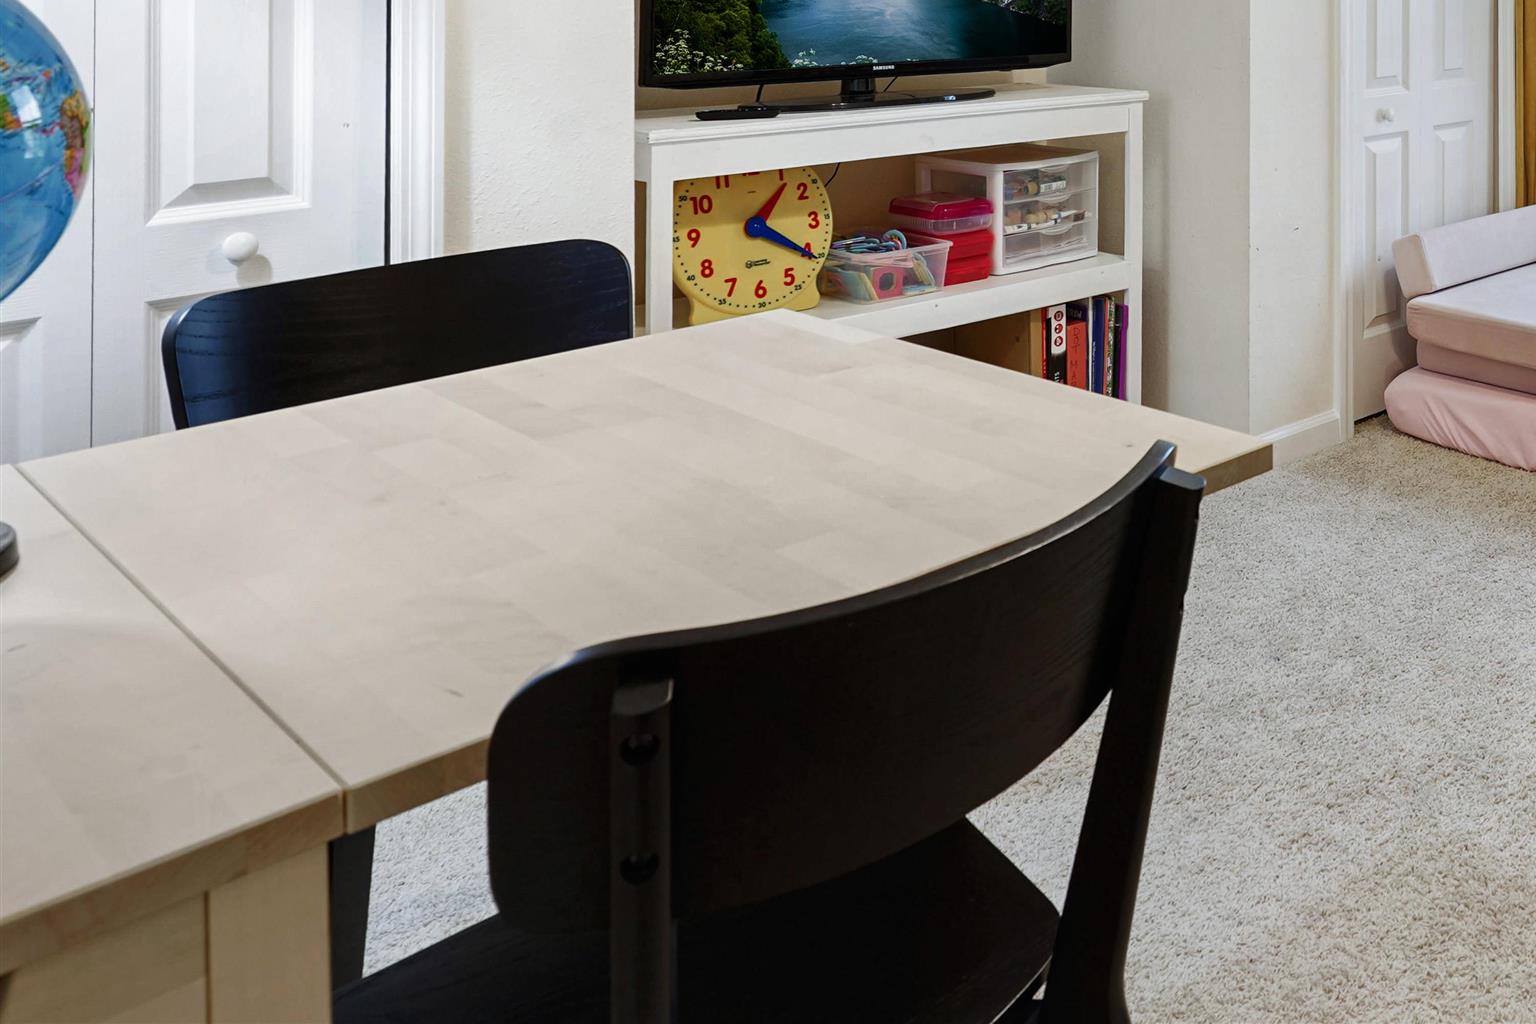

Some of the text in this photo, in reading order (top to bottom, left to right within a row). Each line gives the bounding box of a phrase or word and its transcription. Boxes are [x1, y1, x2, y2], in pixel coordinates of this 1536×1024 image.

[796, 182, 809, 200] 2
[690, 194, 713, 216] 10
[808, 211, 820, 229] 3
[686, 228, 701, 248] 9
[700, 259, 714, 278] 8
[784, 268, 796, 286] 5
[724, 278, 738, 298] 7
[754, 280, 768, 299] 6
